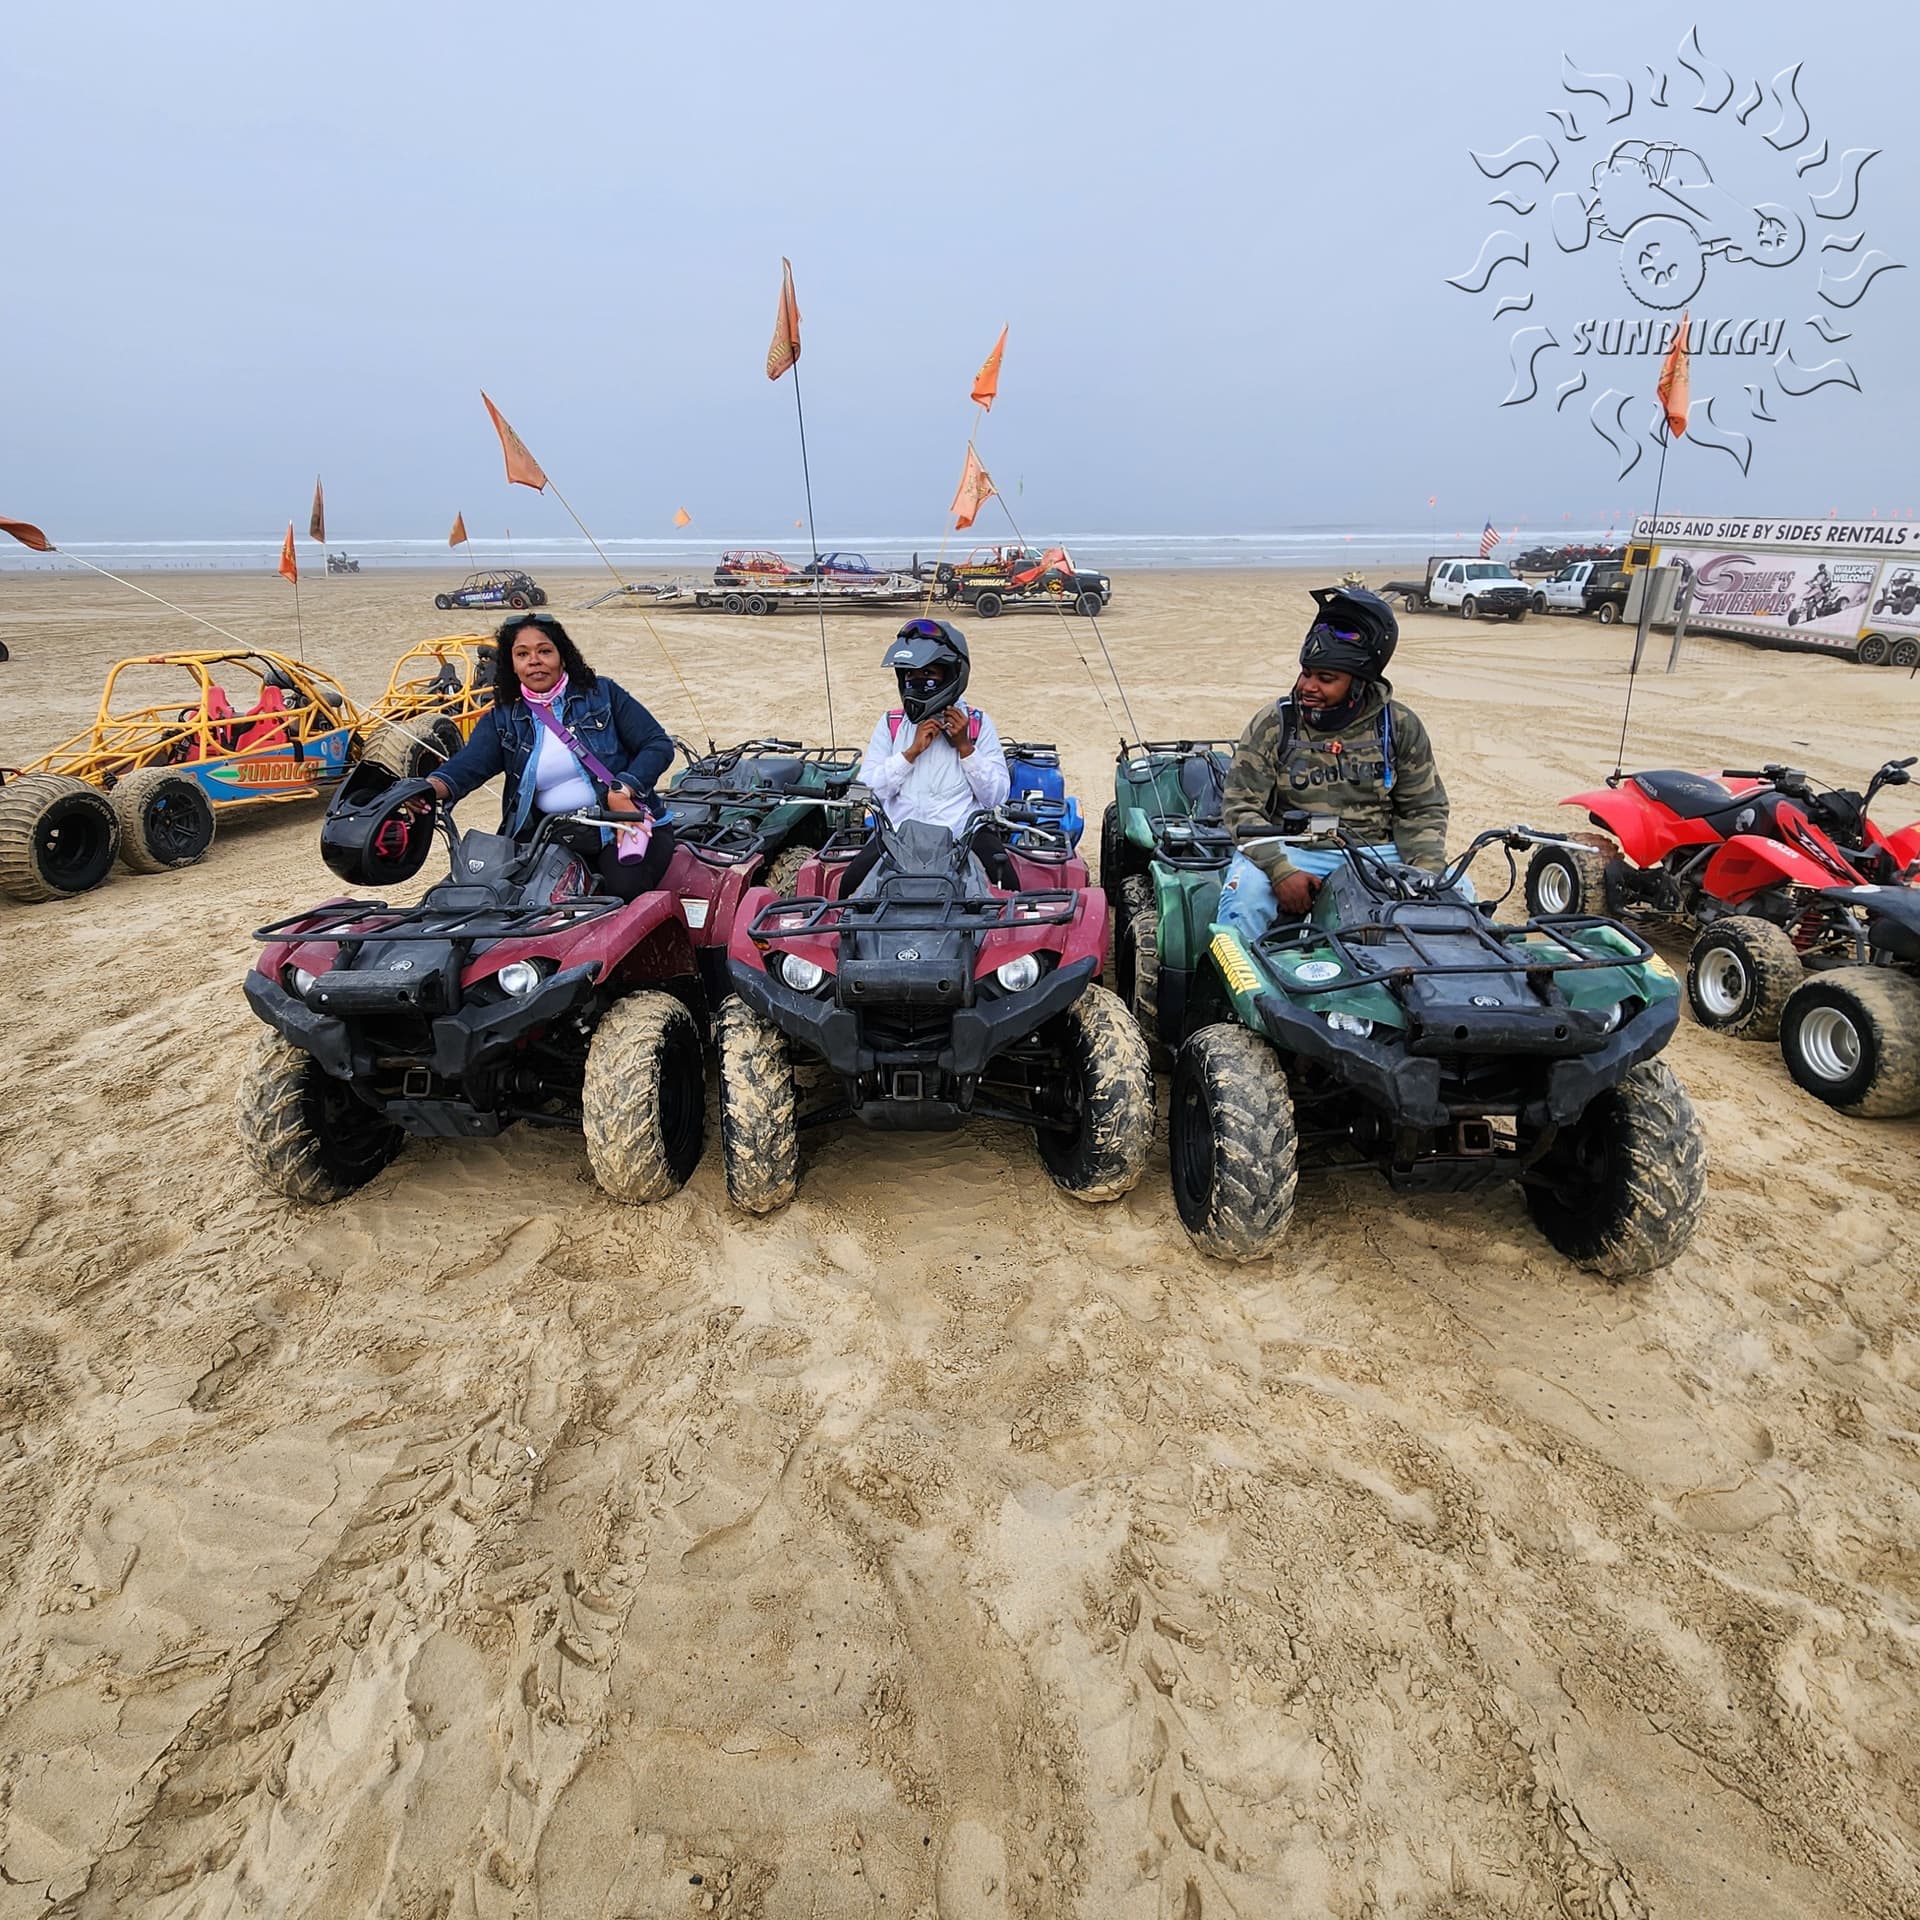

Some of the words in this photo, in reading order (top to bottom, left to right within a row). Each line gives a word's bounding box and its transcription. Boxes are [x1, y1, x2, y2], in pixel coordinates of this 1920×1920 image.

[1639, 520, 1681, 535] QUADS
[1683, 522, 1714, 537] AND
[1717, 523, 1750, 538] SIDE
[1752, 524, 1774, 540] BY
[1776, 525, 1822, 541] SIDES
[1826, 526, 1908, 544] RENTALS
[1832, 573, 1873, 584] WELCOME
[1727, 592, 1796, 615] RENTALS
[237, 761, 320, 783] SUNBUGGY
